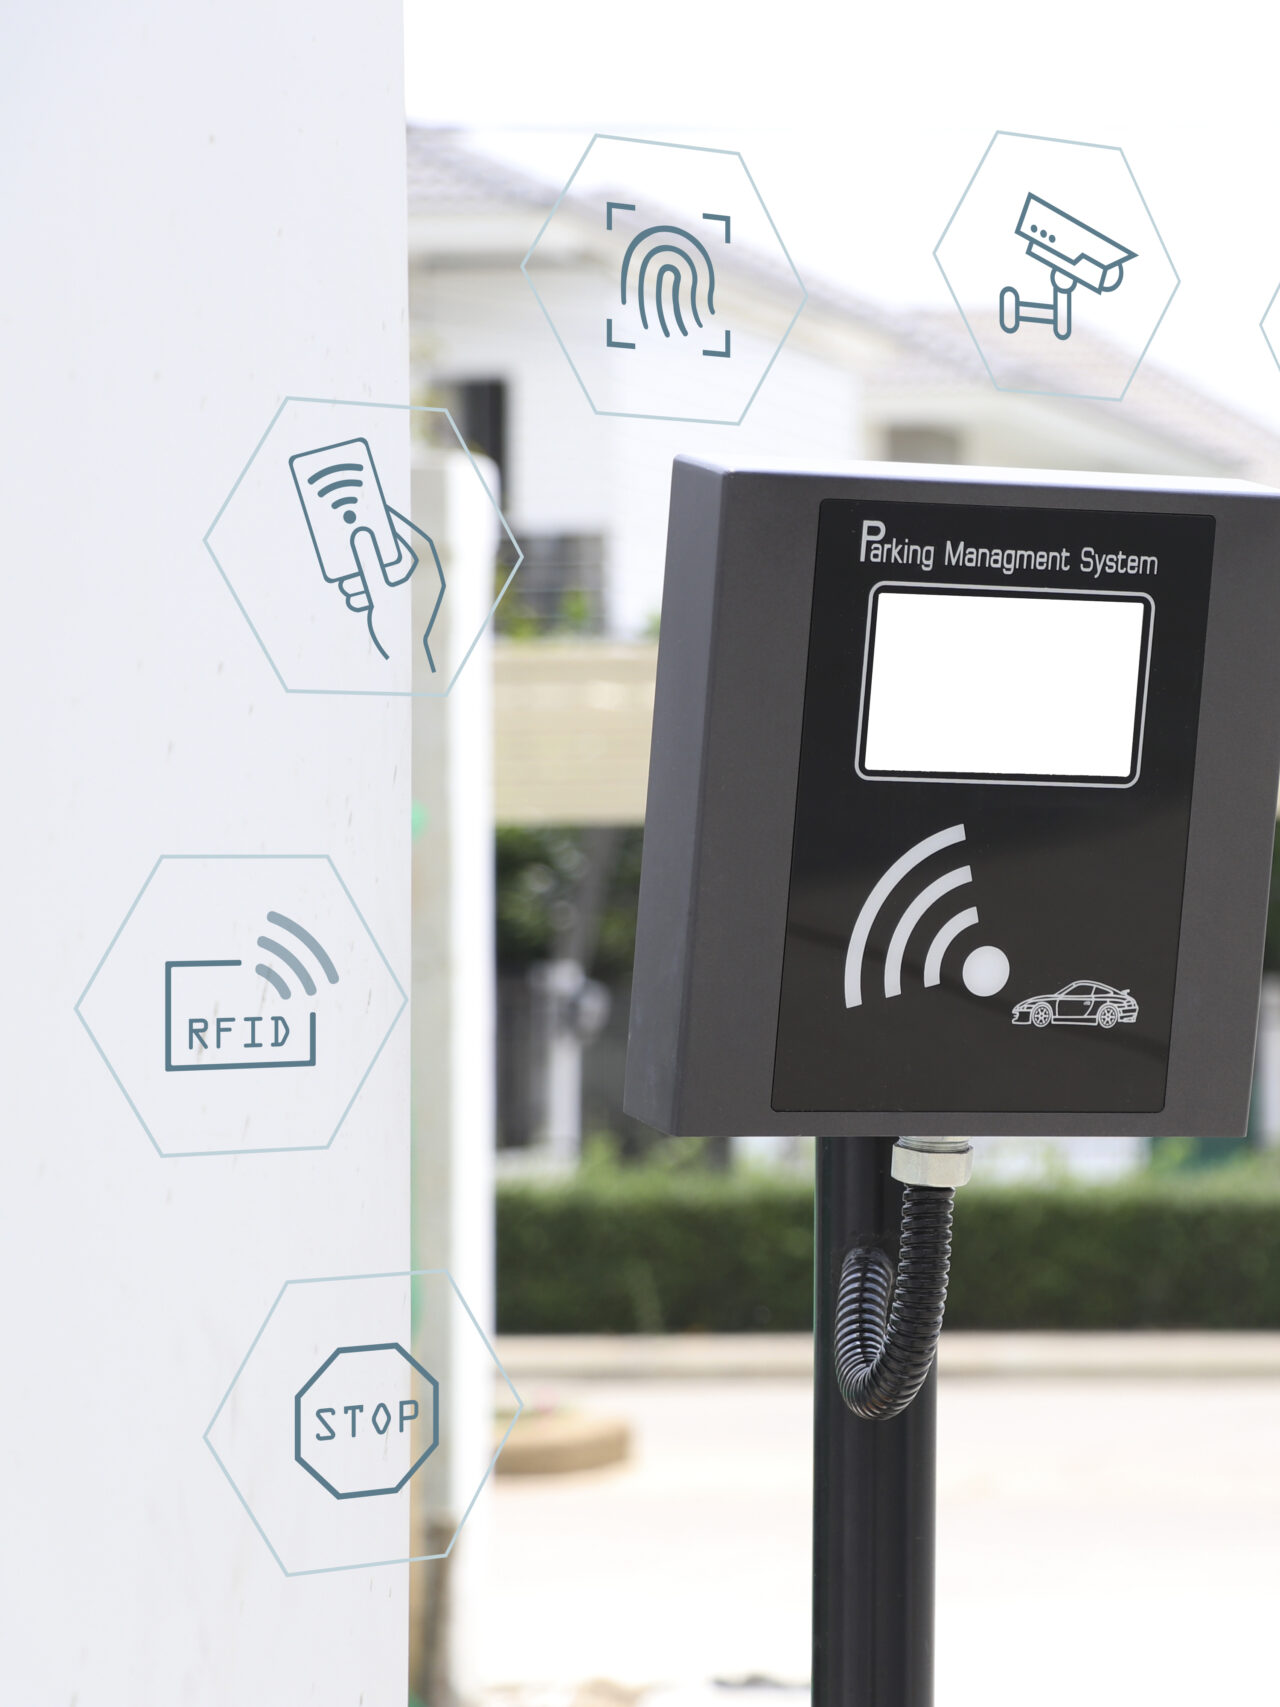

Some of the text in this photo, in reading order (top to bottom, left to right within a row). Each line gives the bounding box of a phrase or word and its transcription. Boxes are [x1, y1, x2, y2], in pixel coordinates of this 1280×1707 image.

[860, 520, 1159, 578] Parking Managment System
